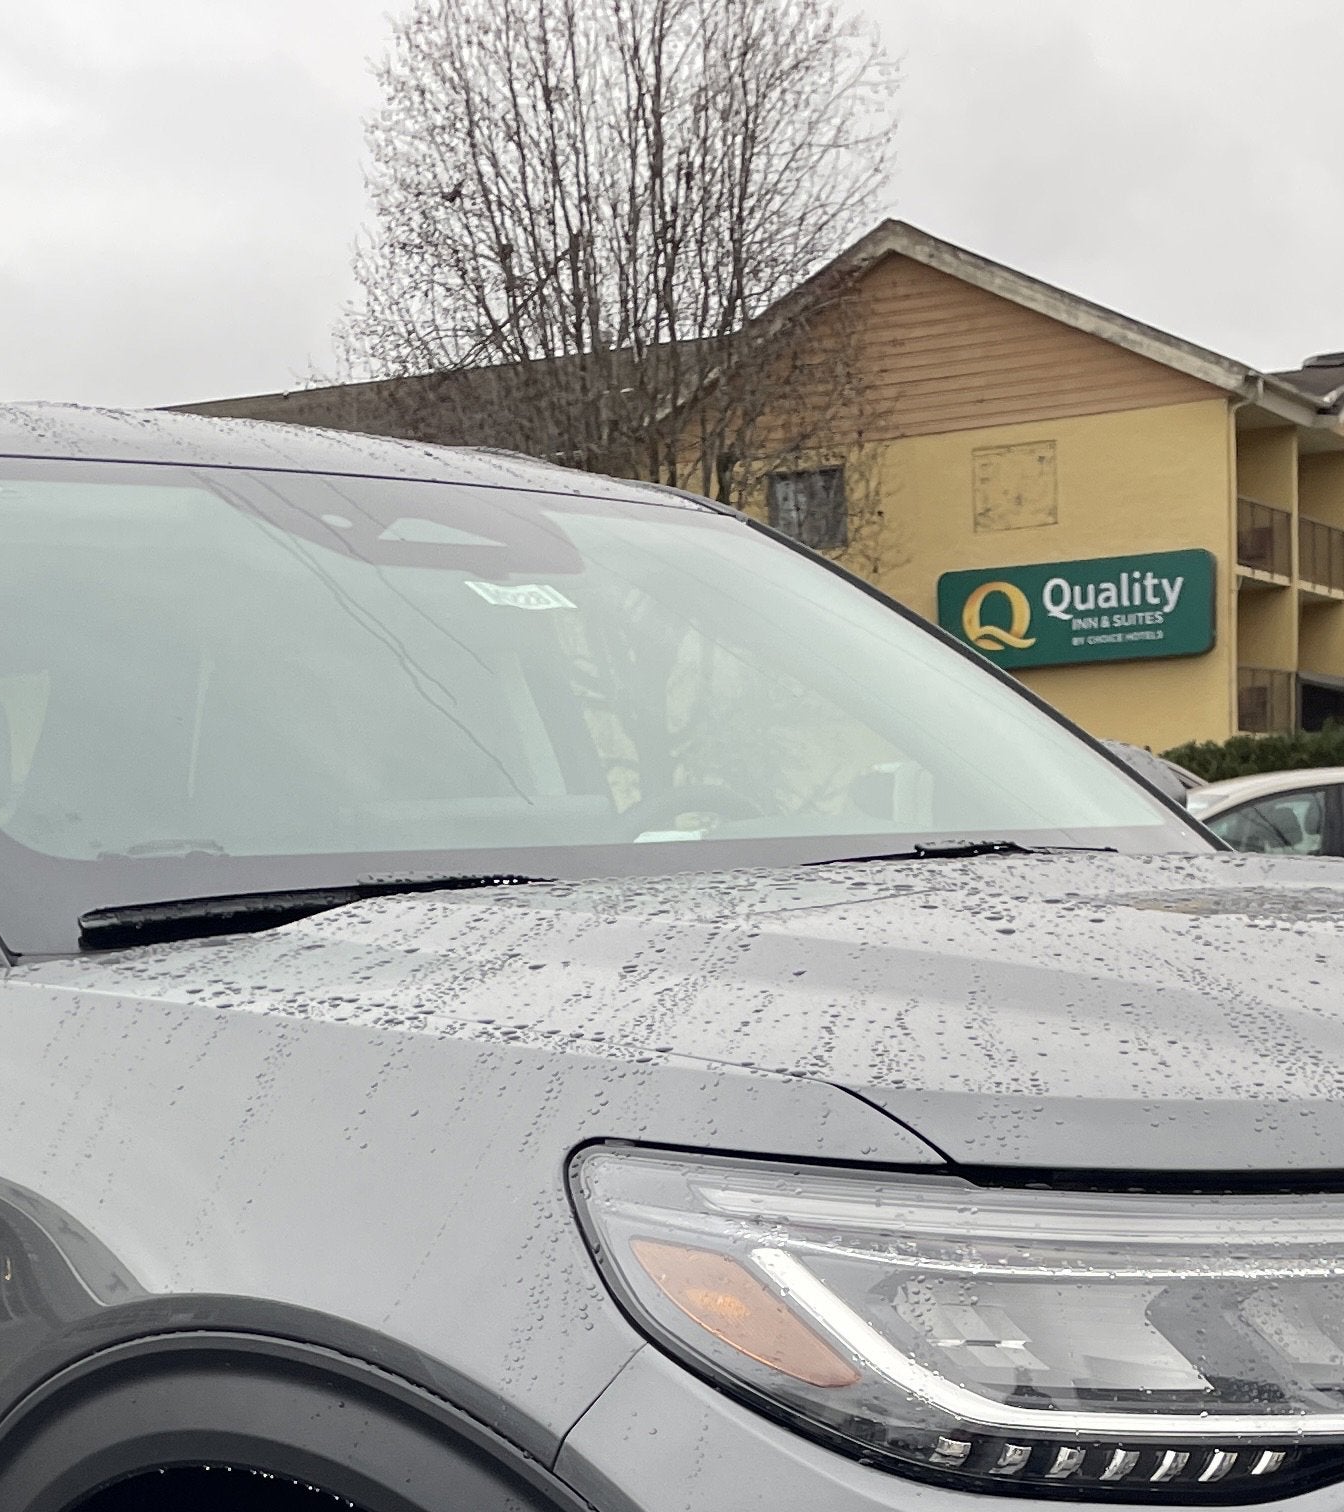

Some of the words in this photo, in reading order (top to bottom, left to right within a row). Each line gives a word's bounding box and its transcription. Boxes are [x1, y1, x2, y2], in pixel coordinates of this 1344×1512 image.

[962, 581, 1036, 650] Q
[1042, 571, 1184, 620] Quality
[1071, 617, 1098, 630] INN
[1100, 615, 1111, 628] &
[1112, 611, 1164, 627] SUITES
